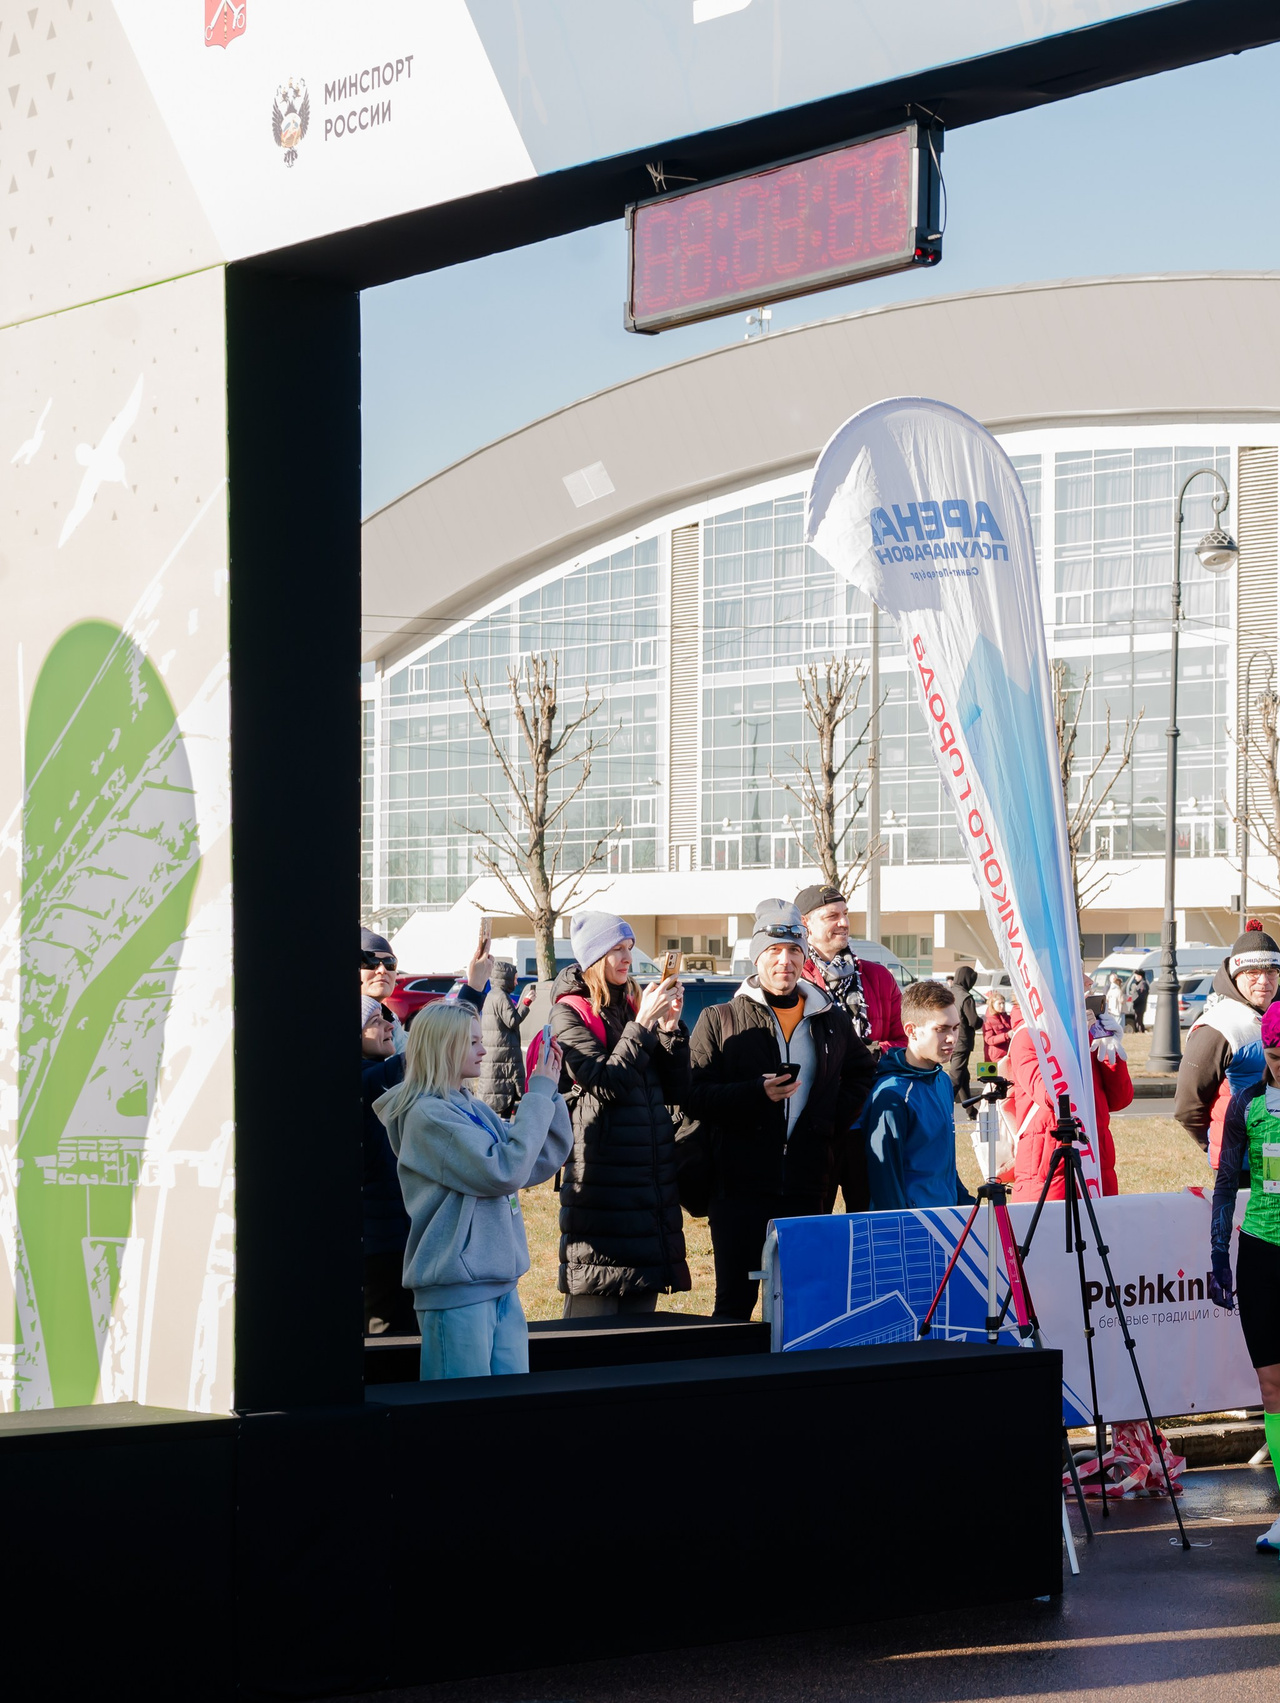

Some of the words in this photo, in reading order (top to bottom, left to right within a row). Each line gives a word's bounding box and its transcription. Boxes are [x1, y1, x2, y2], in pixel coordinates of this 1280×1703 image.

[325, 55, 413, 105] МИНСПОРТ
[325, 100, 391, 141] РОССИИ
[1152, 1309, 1210, 1326] традиции
